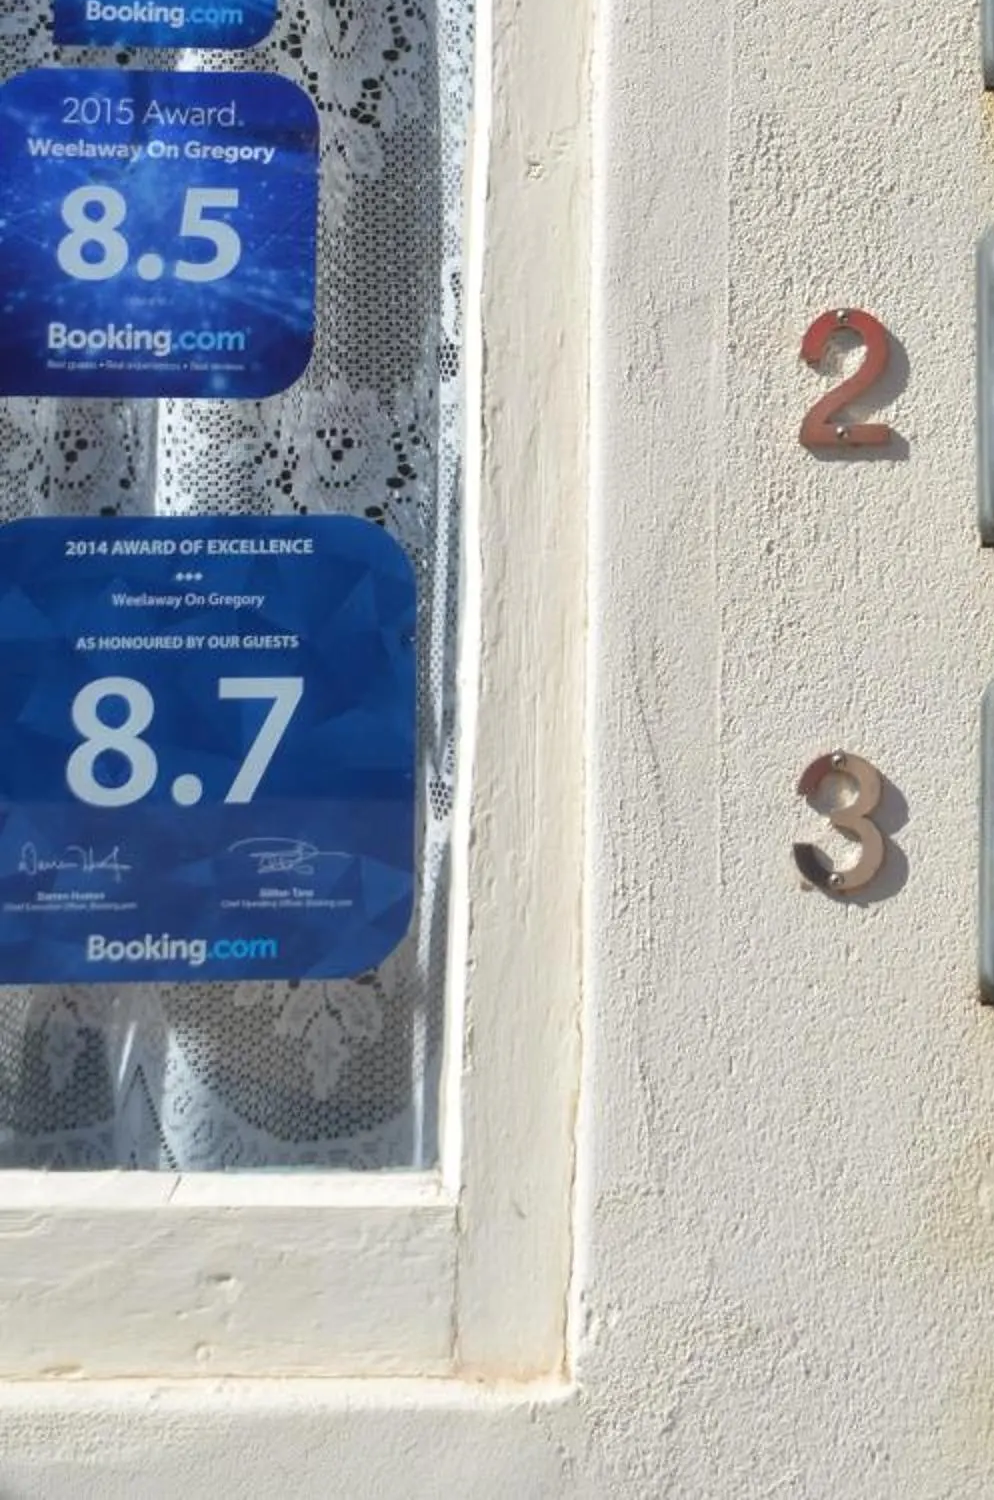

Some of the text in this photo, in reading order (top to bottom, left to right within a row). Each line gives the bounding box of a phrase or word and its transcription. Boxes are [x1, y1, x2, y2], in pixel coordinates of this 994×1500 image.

[85, 0, 244, 28] Booking.com
[61, 97, 245, 127] 2015 Award.
[27, 137, 276, 165] Weelaway On Gregory
[55, 185, 242, 283] 8.5
[47, 322, 246, 356] Booking.com
[799, 308, 889, 445] 2
[65, 538, 314, 556] 2014 AWARD OF EXCELLENCE
[112, 592, 265, 609] Weelaway On Gregory
[76, 634, 300, 650] AS HONOURED BY OUR GUESTS
[66, 676, 305, 808] 8.7
[792, 752, 885, 894] 3
[87, 934, 279, 966] Booking.com
